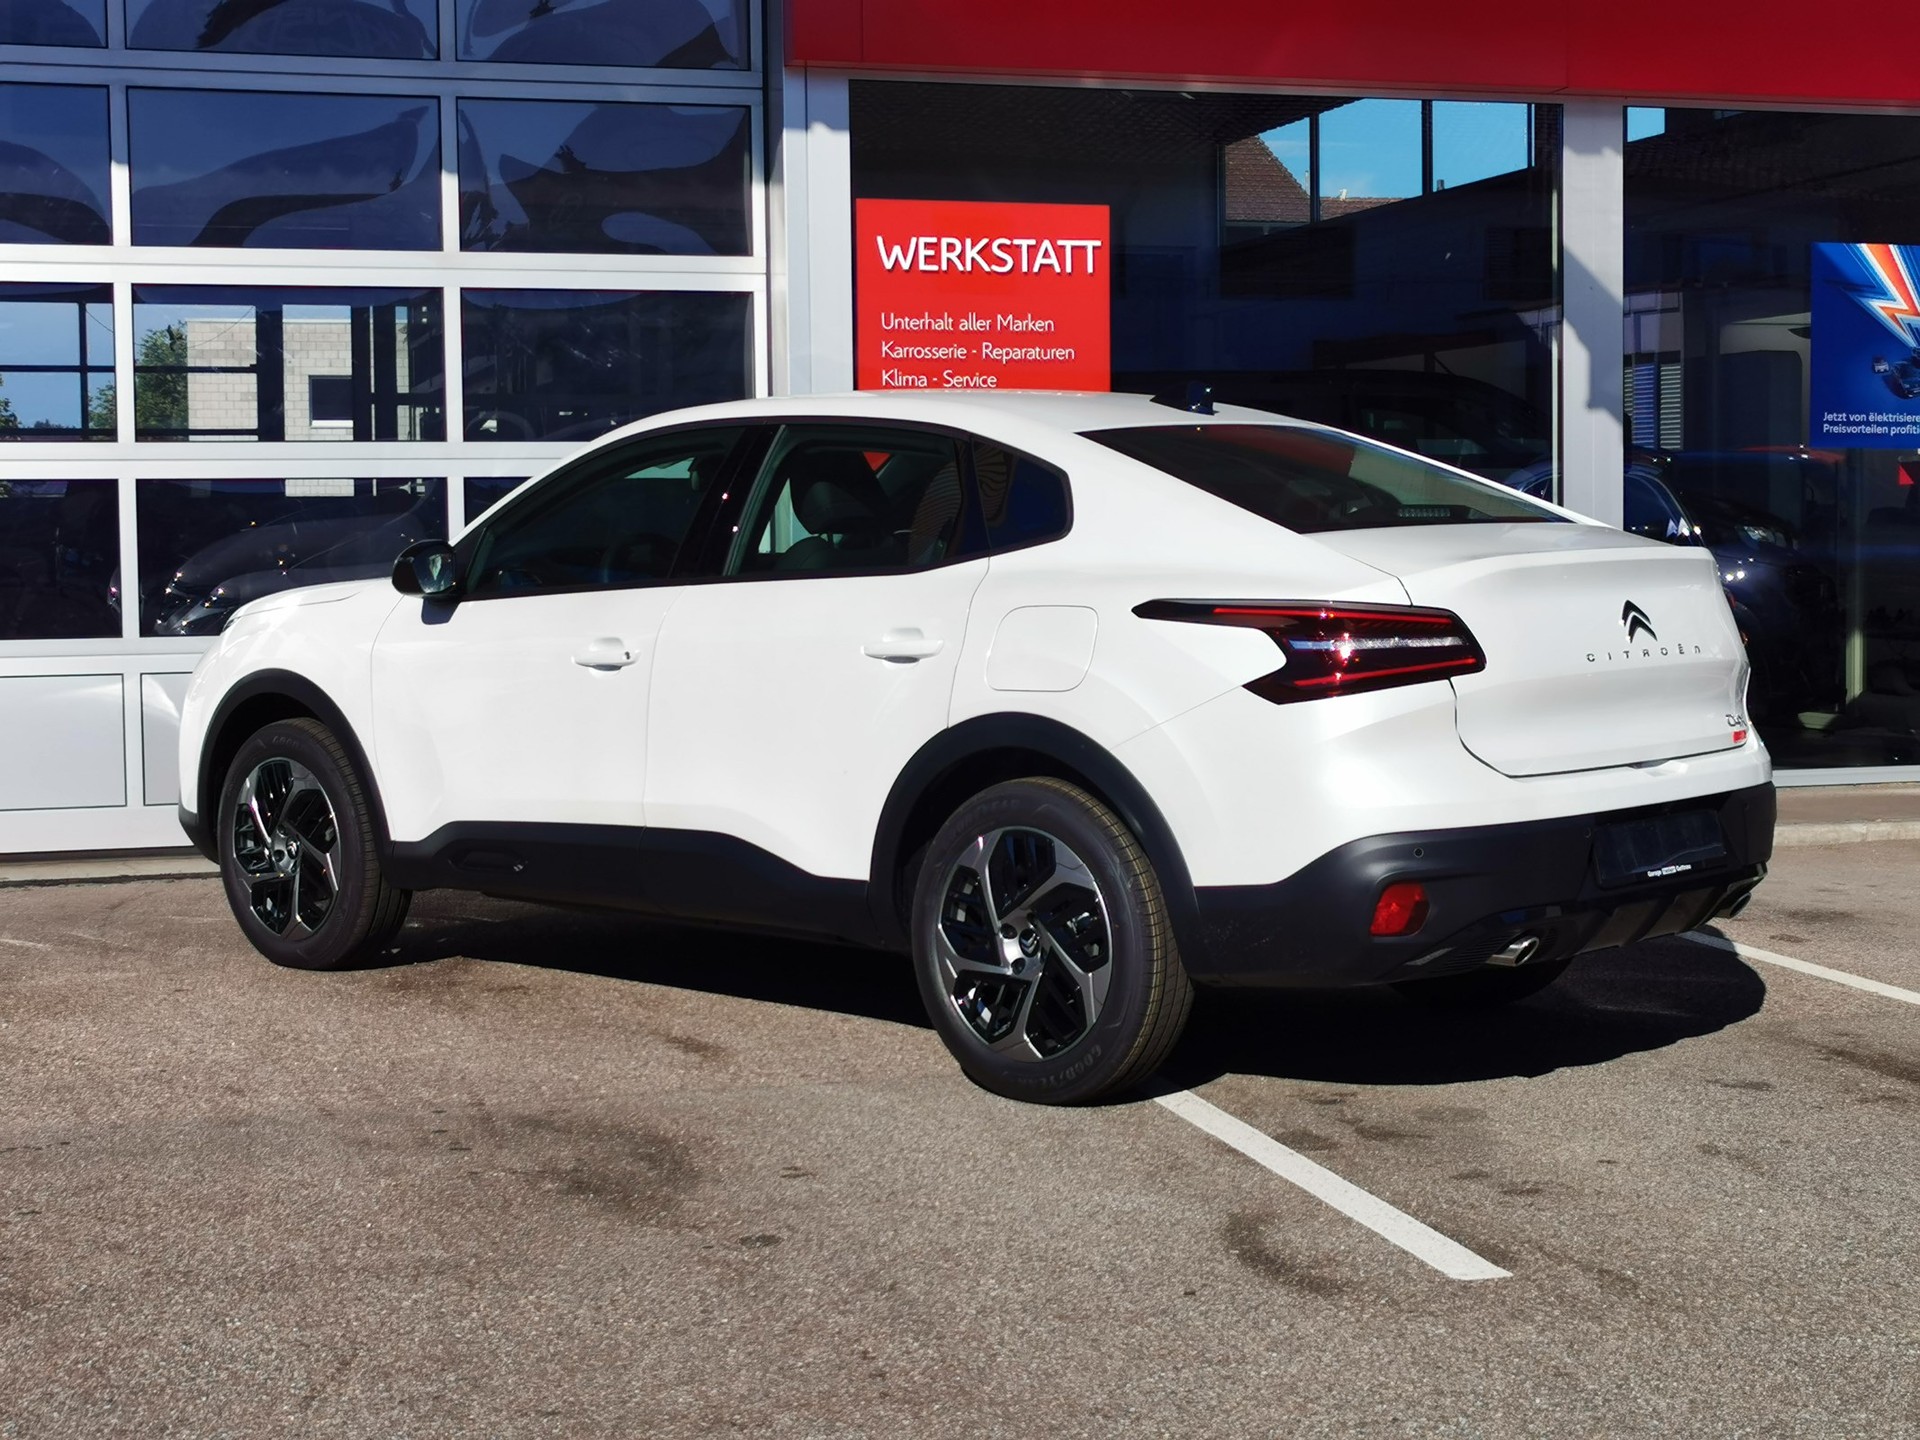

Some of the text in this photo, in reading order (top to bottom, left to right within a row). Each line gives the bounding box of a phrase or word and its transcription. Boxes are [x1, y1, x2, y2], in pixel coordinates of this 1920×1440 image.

[876, 235, 1102, 274] WERKSTATT
[881, 311, 1055, 332] Unterhalt aller Marken
[881, 340, 968, 360] Karrosserie
[982, 341, 1075, 365] Reparaturen
[881, 368, 928, 387] Klima
[942, 369, 998, 388] Service
[1823, 412, 1847, 422] Jetzt
[1849, 414, 1867, 422] von
[1823, 424, 1889, 434] Preisvorteilen
[1586, 642, 1702, 663] CITROËN
